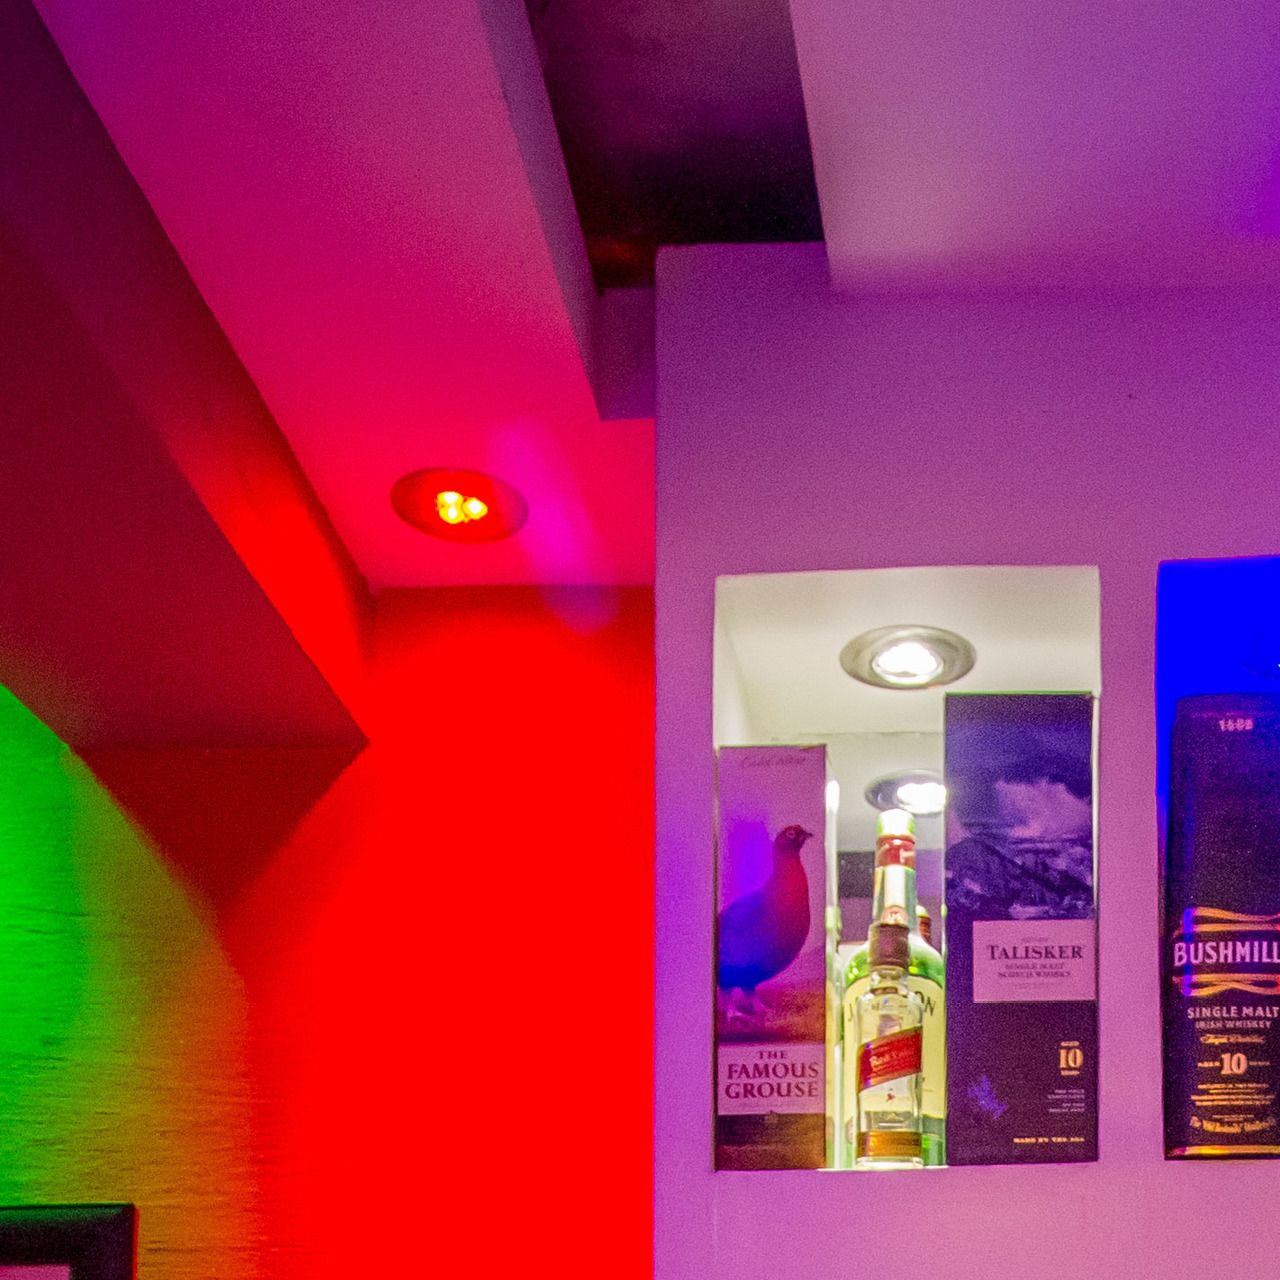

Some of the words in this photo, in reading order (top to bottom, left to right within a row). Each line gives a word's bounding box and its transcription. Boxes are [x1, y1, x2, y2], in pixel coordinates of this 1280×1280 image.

[986, 944, 1084, 960] TALISKER
[1187, 1006, 1239, 1019] SINGLE
[1242, 1006, 1280, 1018] MALT
[757, 1050, 788, 1060] THE
[1059, 1049, 1084, 1069] 10
[727, 1062, 820, 1079] FAMOUS
[1220, 1053, 1248, 1075] 10
[724, 1081, 820, 1099] GROUSE
